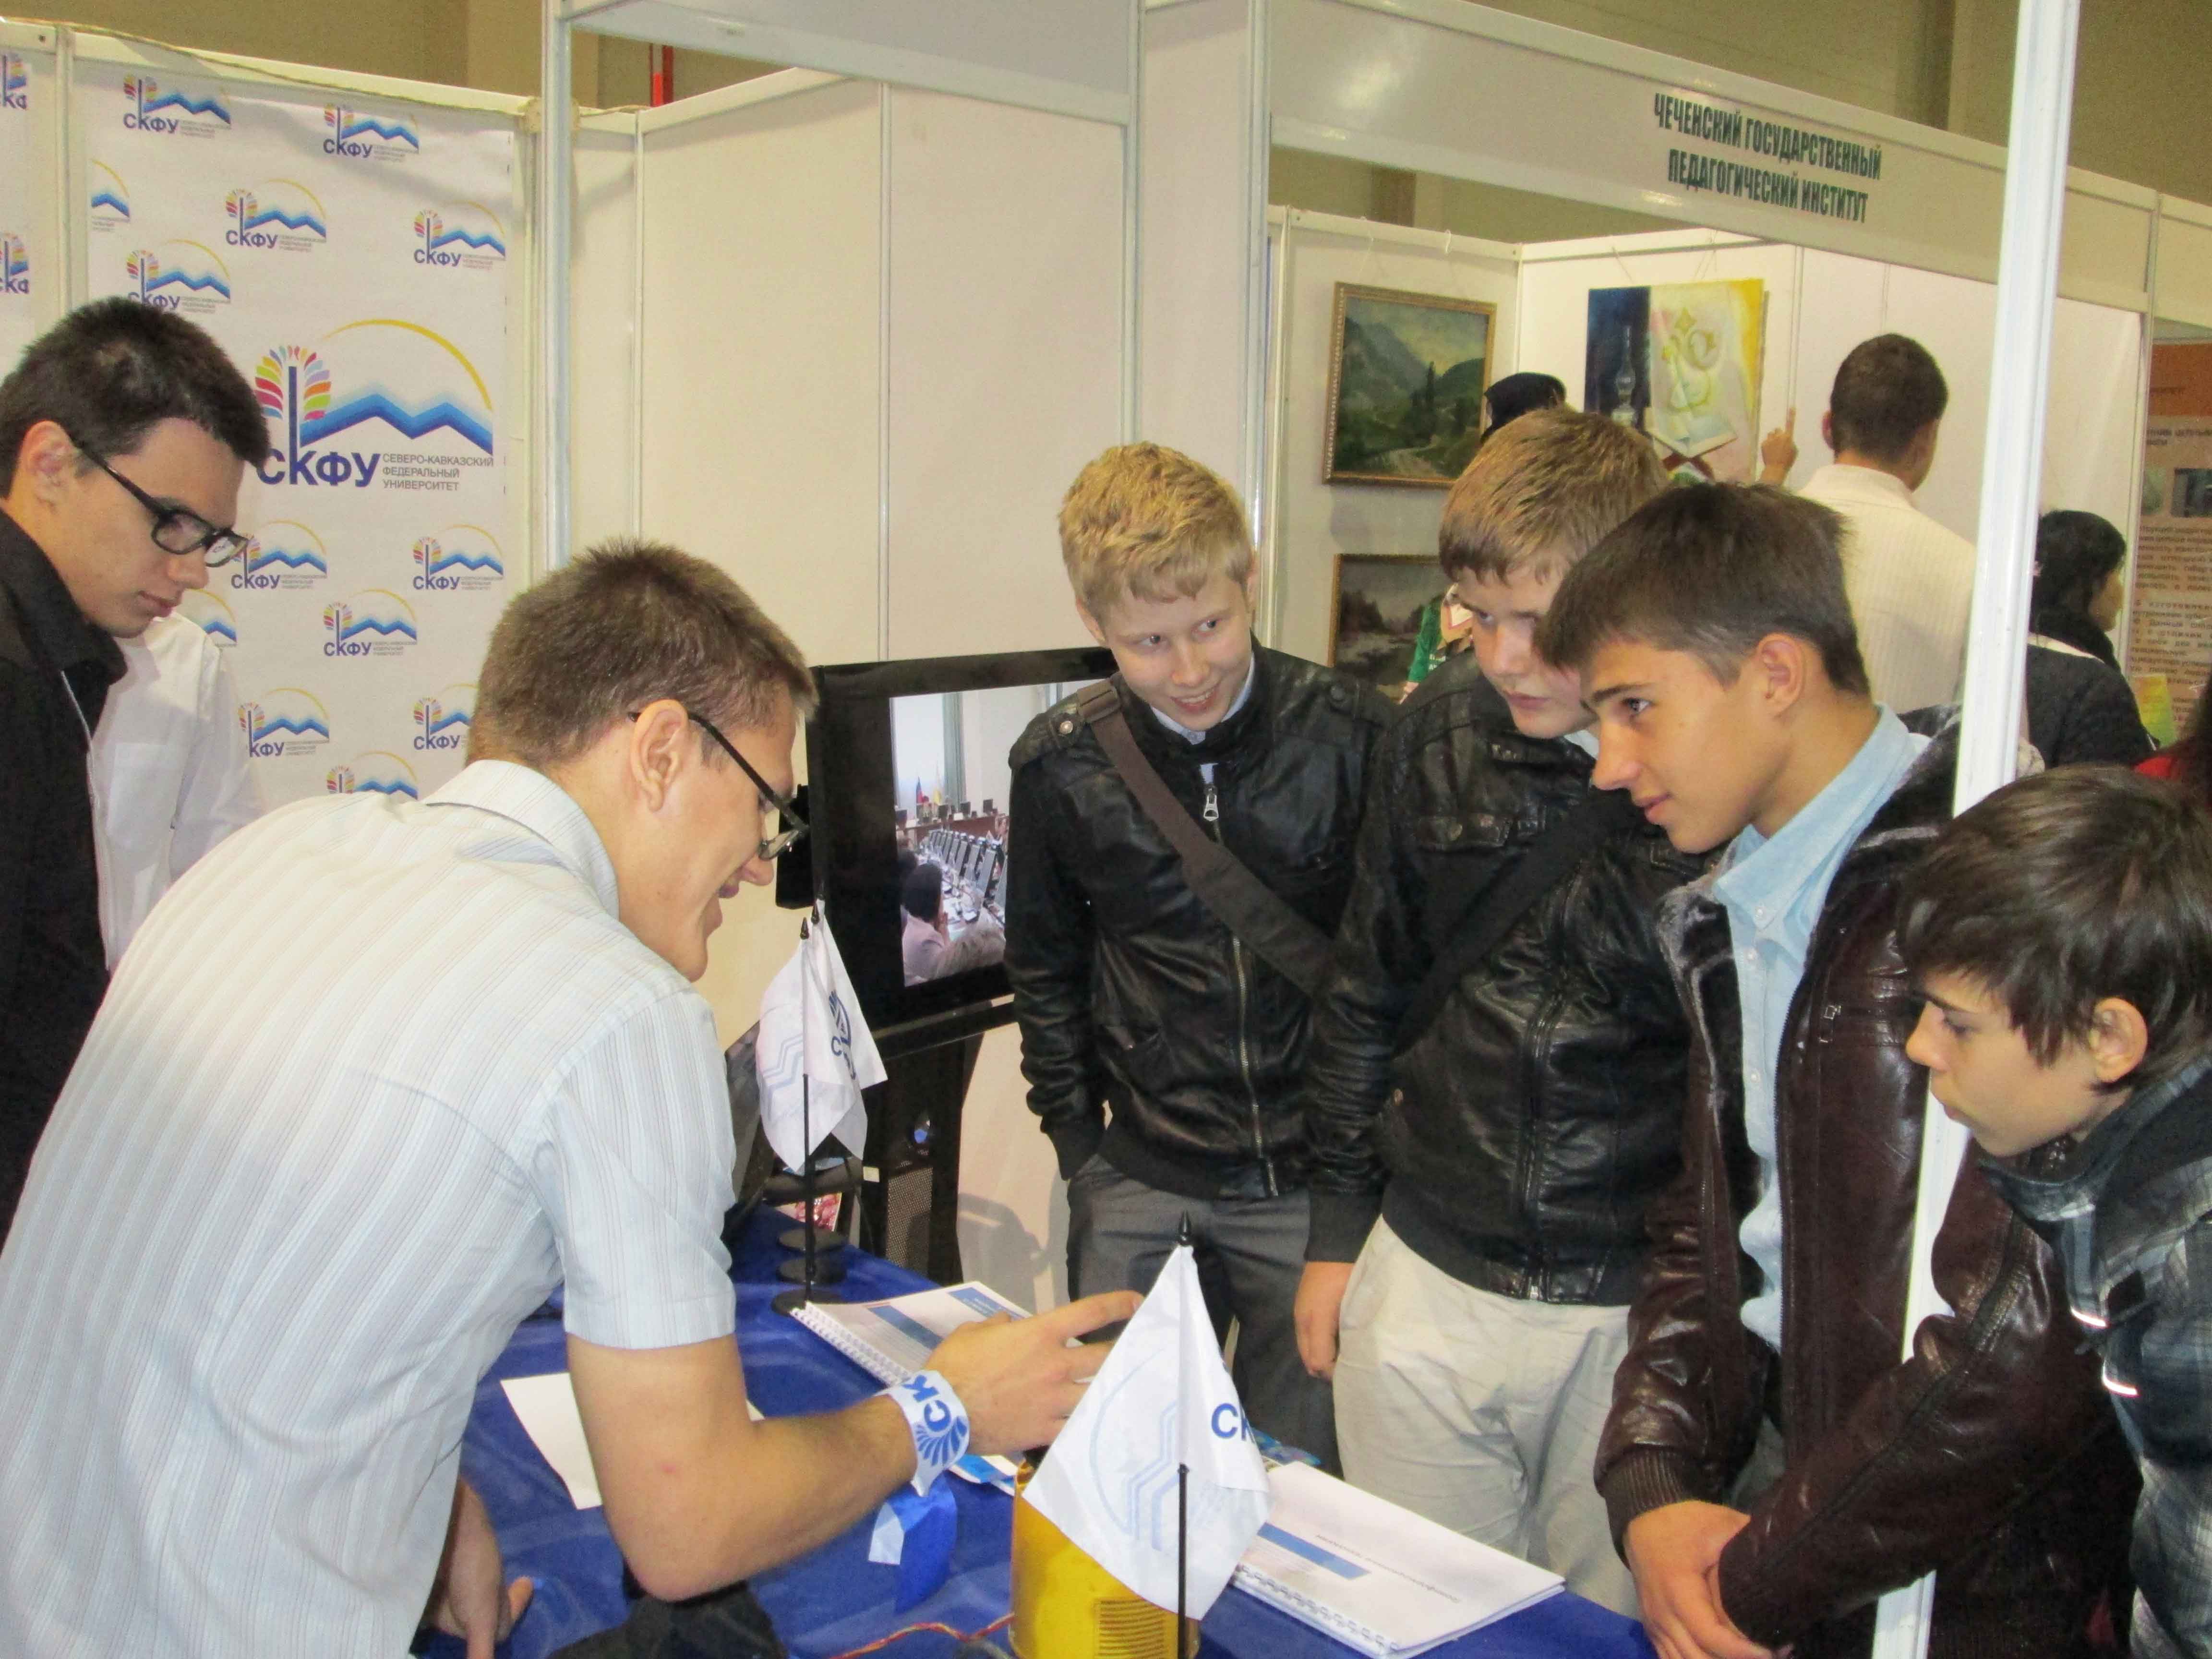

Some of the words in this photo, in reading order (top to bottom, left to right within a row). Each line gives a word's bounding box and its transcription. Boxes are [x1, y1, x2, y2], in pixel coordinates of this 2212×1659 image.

[123, 113, 179, 134] СКФУ
[1654, 92, 1743, 148] ЧЕЧЕНСКИЙ
[1744, 118, 1882, 180] ГОСУДАРСТВЕННЫЙ
[323, 139, 373, 158] СКФУ
[1668, 148, 1799, 209] ПЕДАГОГИЧЕСКИЙ
[1801, 179, 1868, 223] ИНСТИТУТ
[226, 230, 278, 249] СКФУ
[413, 249, 462, 267] СКФУ
[383, 453, 494, 468] СЕВЕРО-КАВКАЗСКИЙ
[383, 467, 460, 478] ФЕДЕРАЛЬНЫЙ
[383, 479, 459, 491] УНИВЕРСИТЕТ
[231, 574, 281, 589] СКФУ
[413, 576, 460, 590] СКФУ
[324, 642, 372, 657] СКФУ
[249, 742, 285, 757] КФУ
[413, 735, 460, 750] СКФУ
